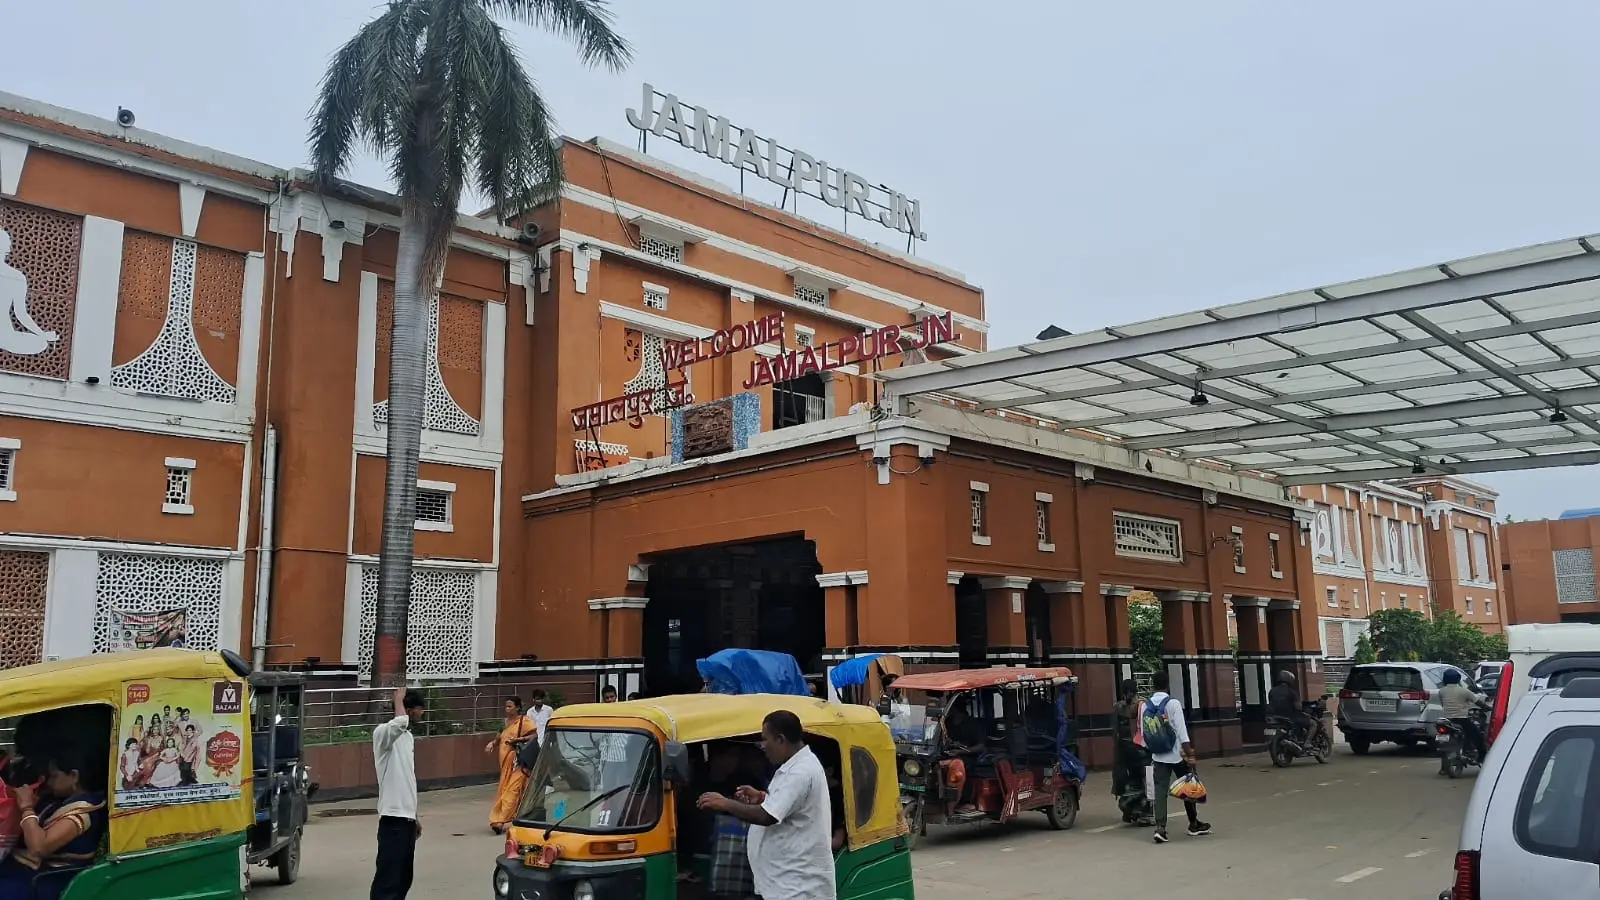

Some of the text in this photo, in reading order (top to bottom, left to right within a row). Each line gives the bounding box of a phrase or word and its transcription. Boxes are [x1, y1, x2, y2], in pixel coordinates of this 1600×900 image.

[626, 82, 927, 241] JAMALPUR JN.
[659, 310, 786, 372] WELCOME
[743, 311, 962, 389] JAMALPUR JN.
[570, 388, 655, 431] जमालपुर
[225, 691, 234, 701] V
